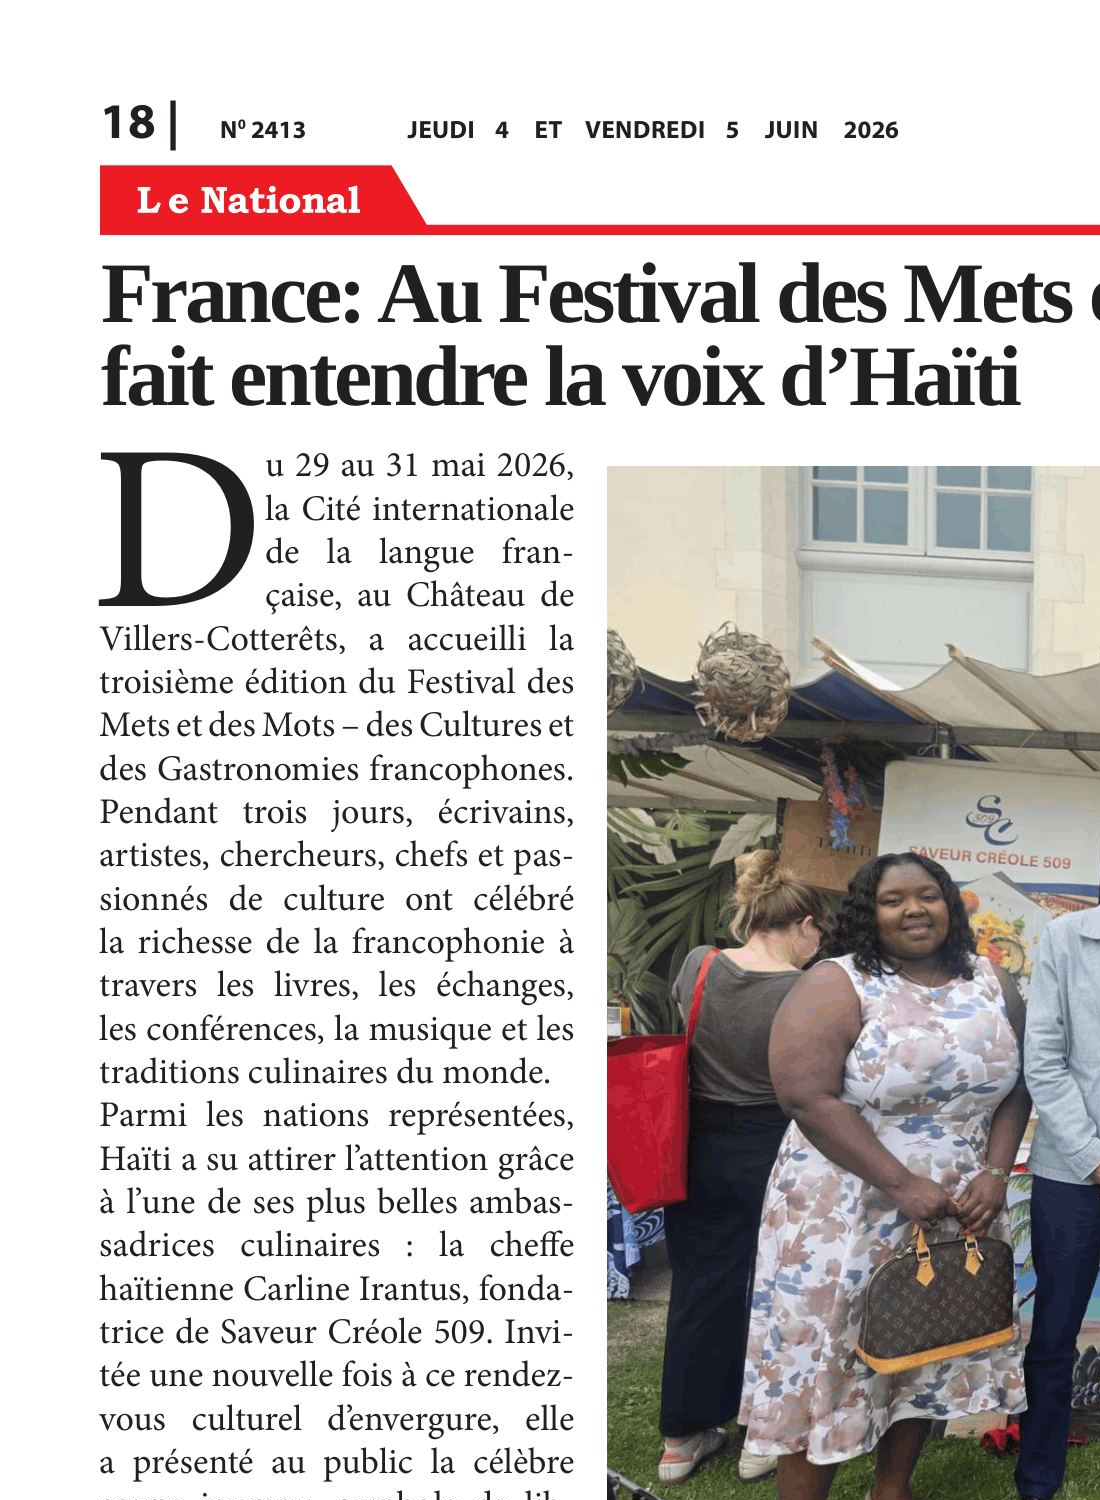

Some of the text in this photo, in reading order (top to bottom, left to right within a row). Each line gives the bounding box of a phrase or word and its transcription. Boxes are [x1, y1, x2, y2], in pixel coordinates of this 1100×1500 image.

[104, 105, 154, 139] 18
[252, 121, 305, 138] 2413
[407, 121, 898, 138] JEUDI 4 ET VENDREDI 5 JUIN 2026
[201, 185, 361, 214] National
[102, 265, 359, 323] France:
[378, 265, 482, 323] Au
[499, 262, 760, 323] Festival
[779, 262, 887, 323] des
[904, 265, 1073, 323] Mets
[102, 344, 1021, 406] fait entendre la voix d’Haïti
[265, 494, 573, 521] la Cité internationale
[100, 624, 574, 654] Villers-Cotterêts, a accueilli la
[100, 797, 573, 832] Pendant trois jours, écrivains,
[977, 850, 1038, 868] CRÉOLE
[1043, 856, 1072, 870] 509
[100, 1100, 573, 1135] Parmi les nations représentées,
[100, 1274, 572, 1304] haïtienne Carline Irantus, fonda-
[99, 1404, 573, 1439] vous culturel d’envergure, elle
